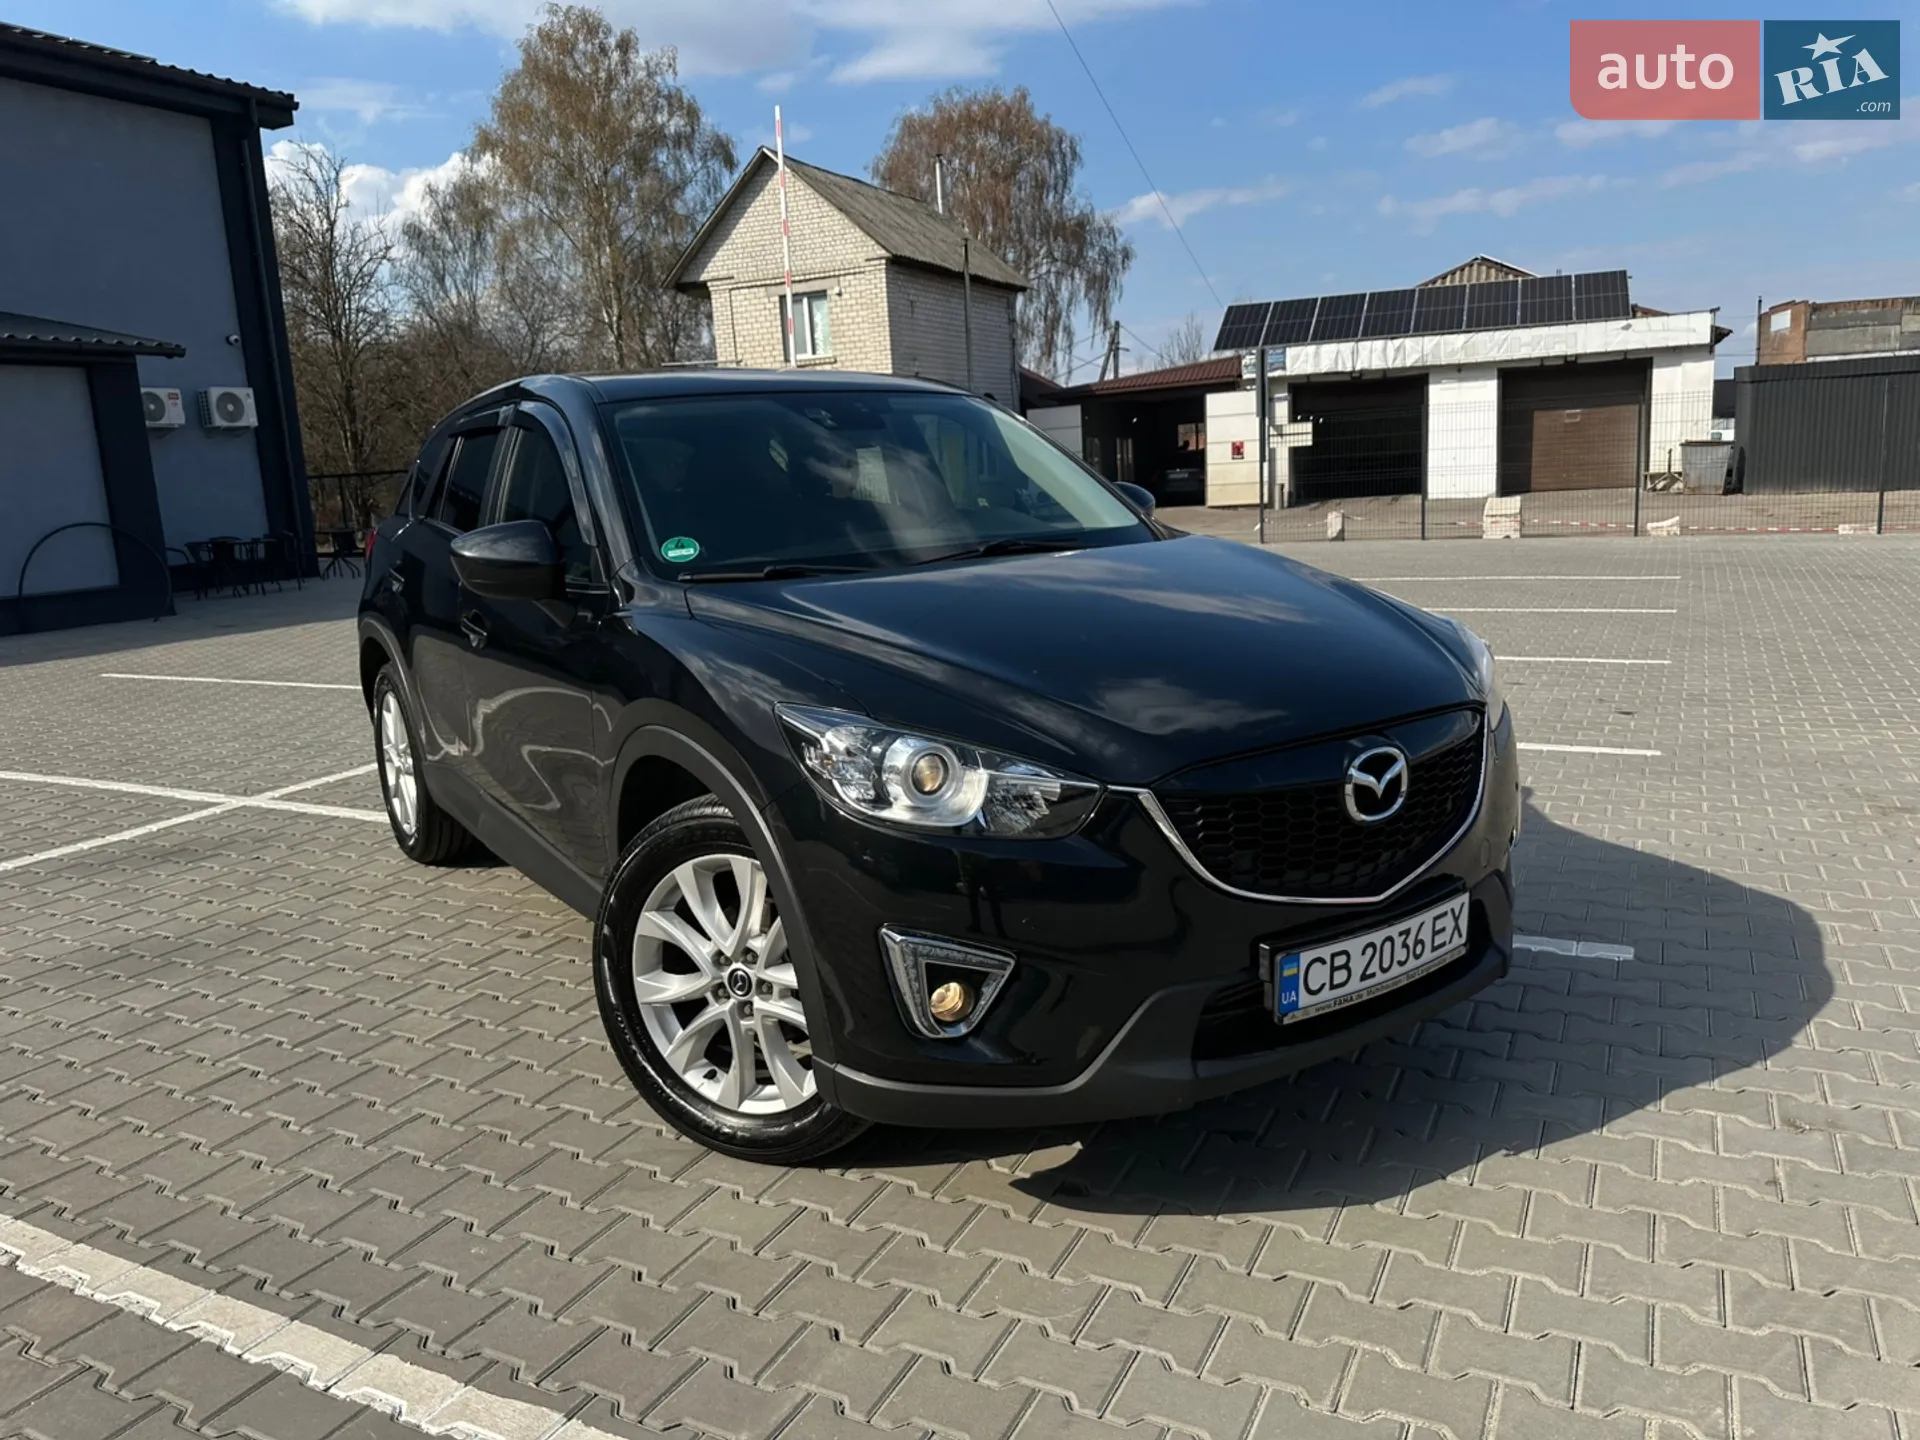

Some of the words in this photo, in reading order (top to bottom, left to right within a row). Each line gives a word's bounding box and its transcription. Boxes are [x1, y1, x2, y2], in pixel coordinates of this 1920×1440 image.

[1303, 949, 1353, 996] CB
[1359, 920, 1426, 983] 2036
[1431, 901, 1466, 954] EX
[1281, 991, 1297, 1004] UA
